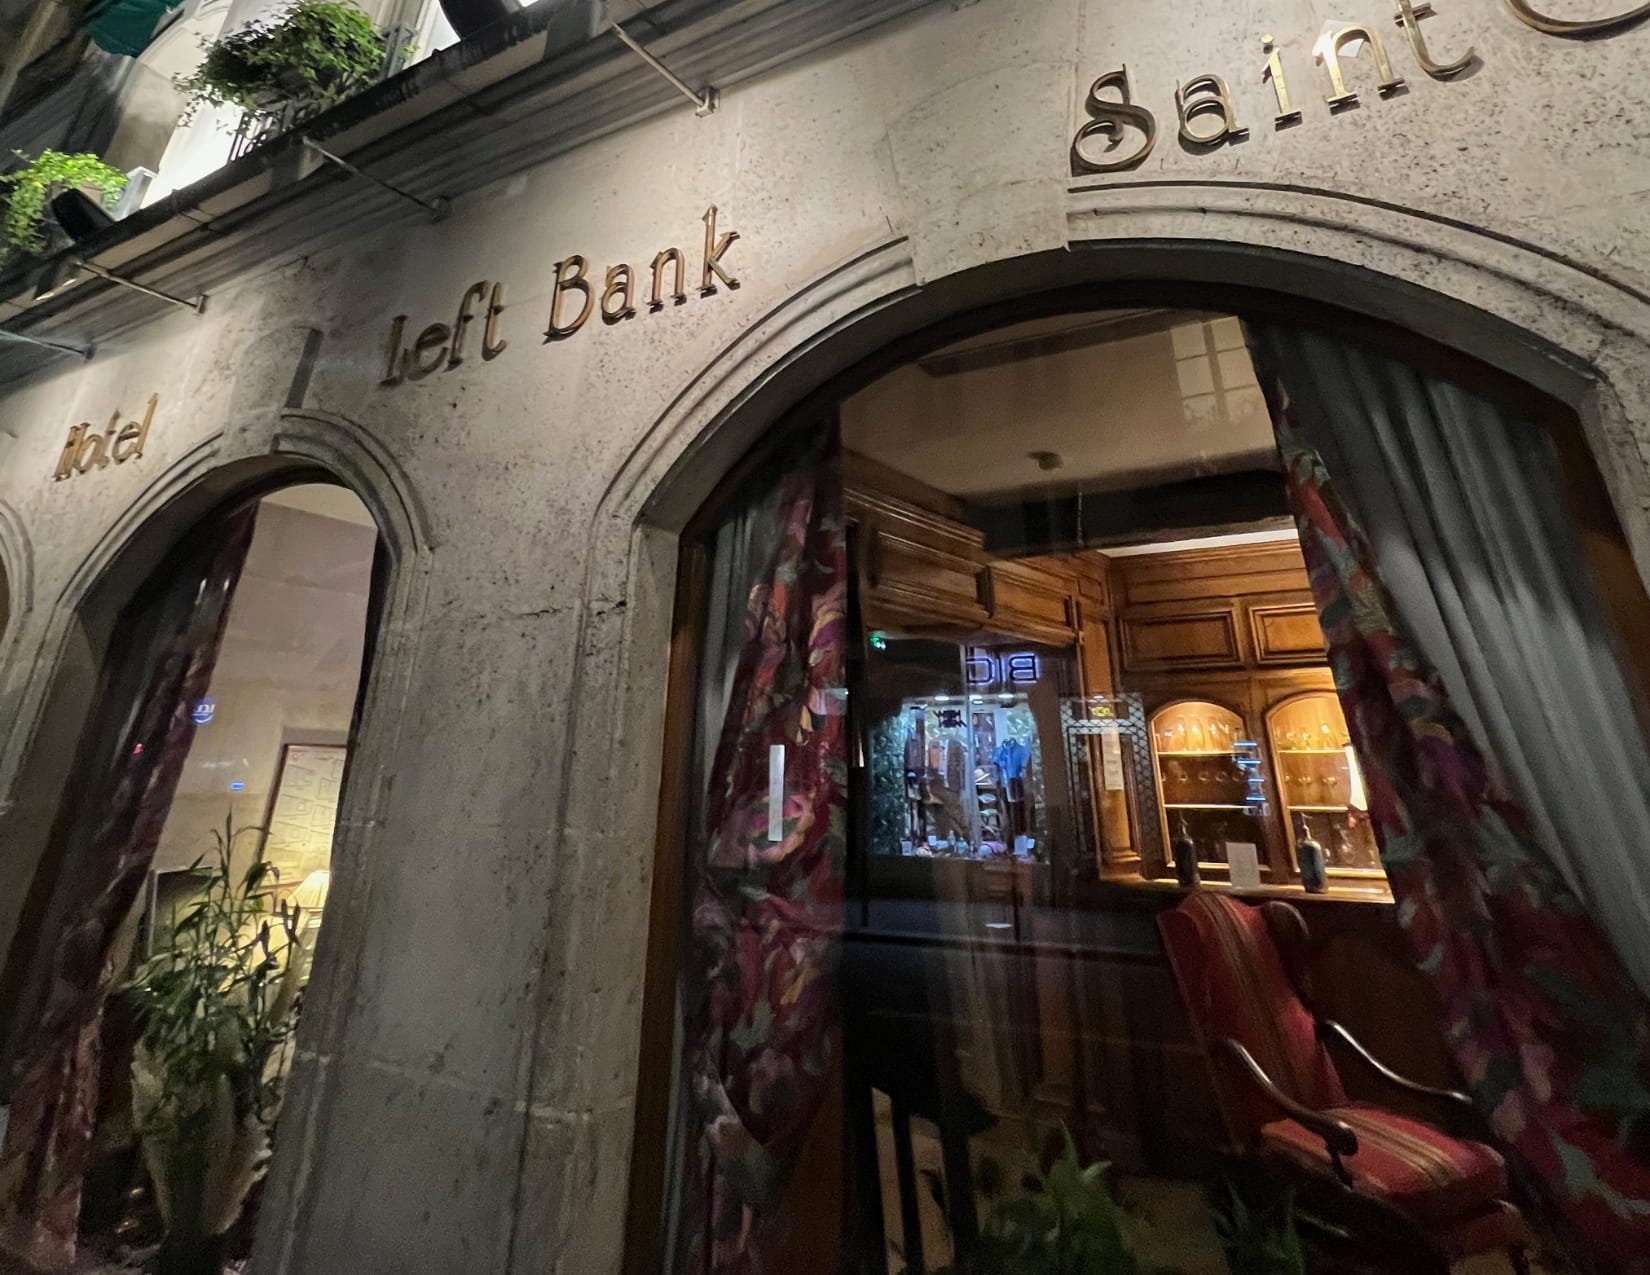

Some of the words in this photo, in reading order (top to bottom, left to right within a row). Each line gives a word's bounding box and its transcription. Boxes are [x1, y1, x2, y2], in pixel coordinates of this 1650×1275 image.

[53, 392, 158, 482] Hotel
[379, 280, 507, 386] Left
[543, 203, 741, 343] Bank
[1071, 0, 1478, 174] Saint
